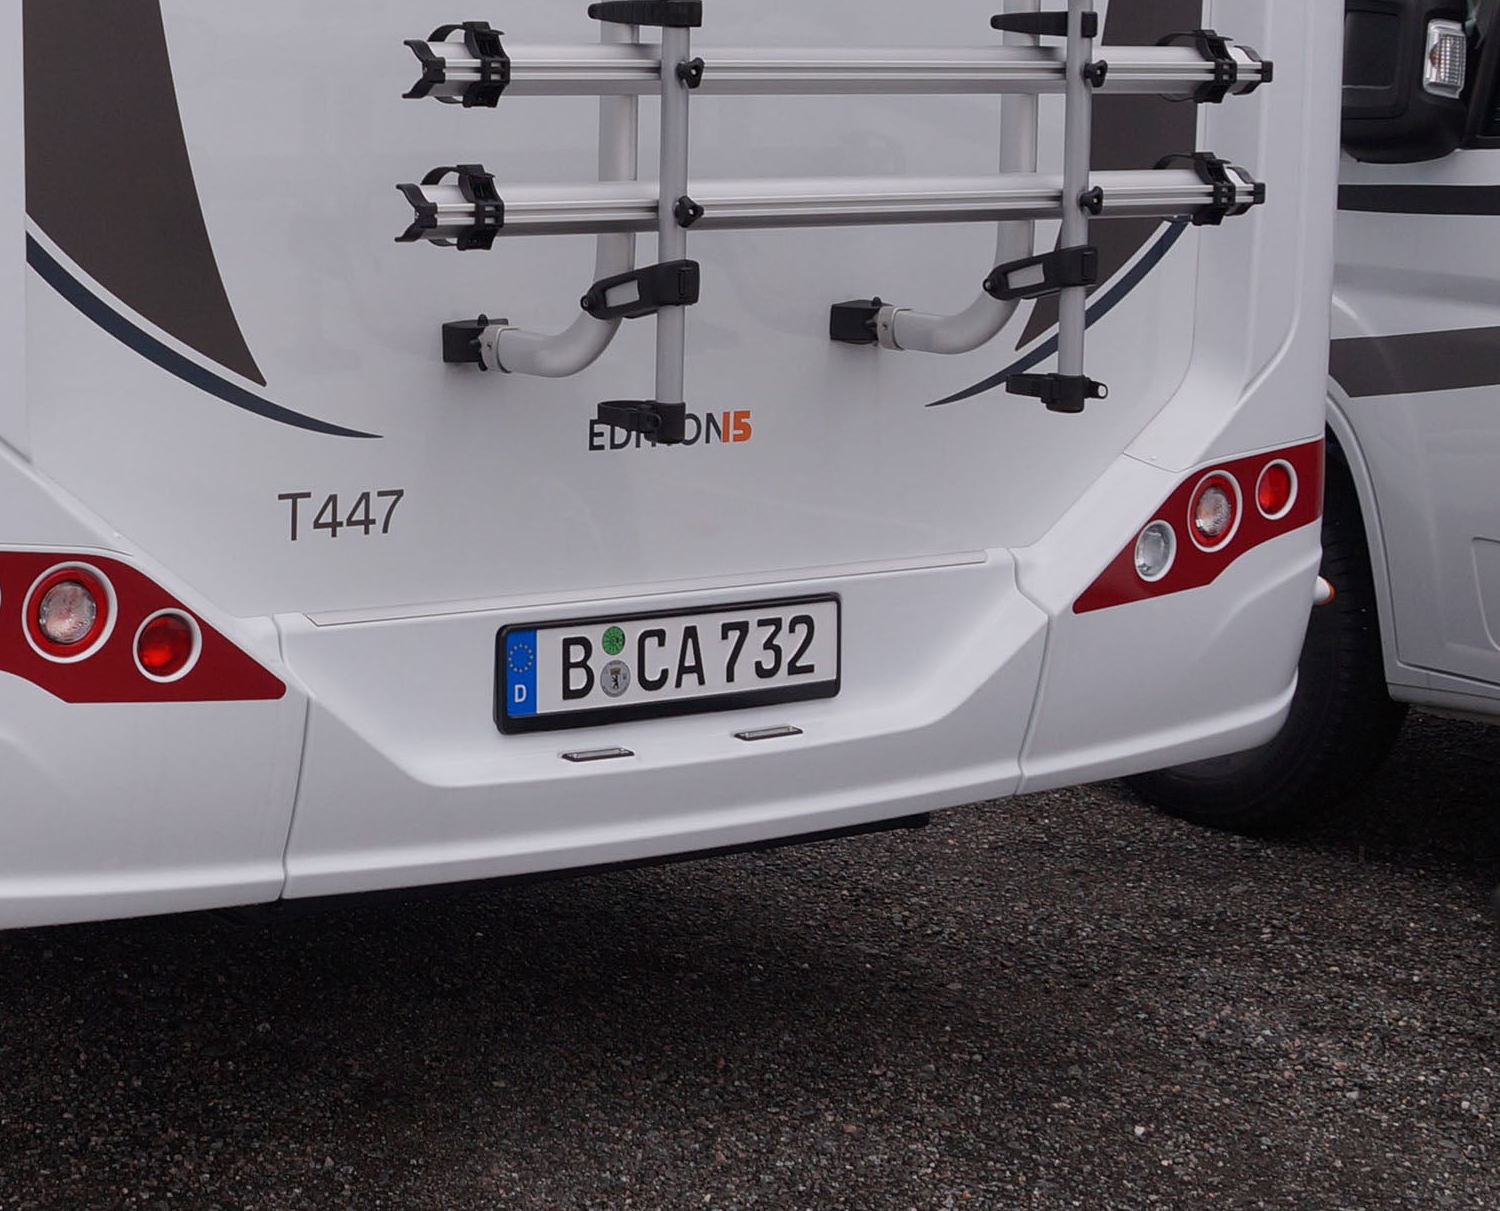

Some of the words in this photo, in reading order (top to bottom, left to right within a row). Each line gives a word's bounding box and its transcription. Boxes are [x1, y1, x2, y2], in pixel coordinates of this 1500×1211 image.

[277, 488, 405, 541] T447
[514, 684, 528, 703] D
[562, 635, 595, 701] B
